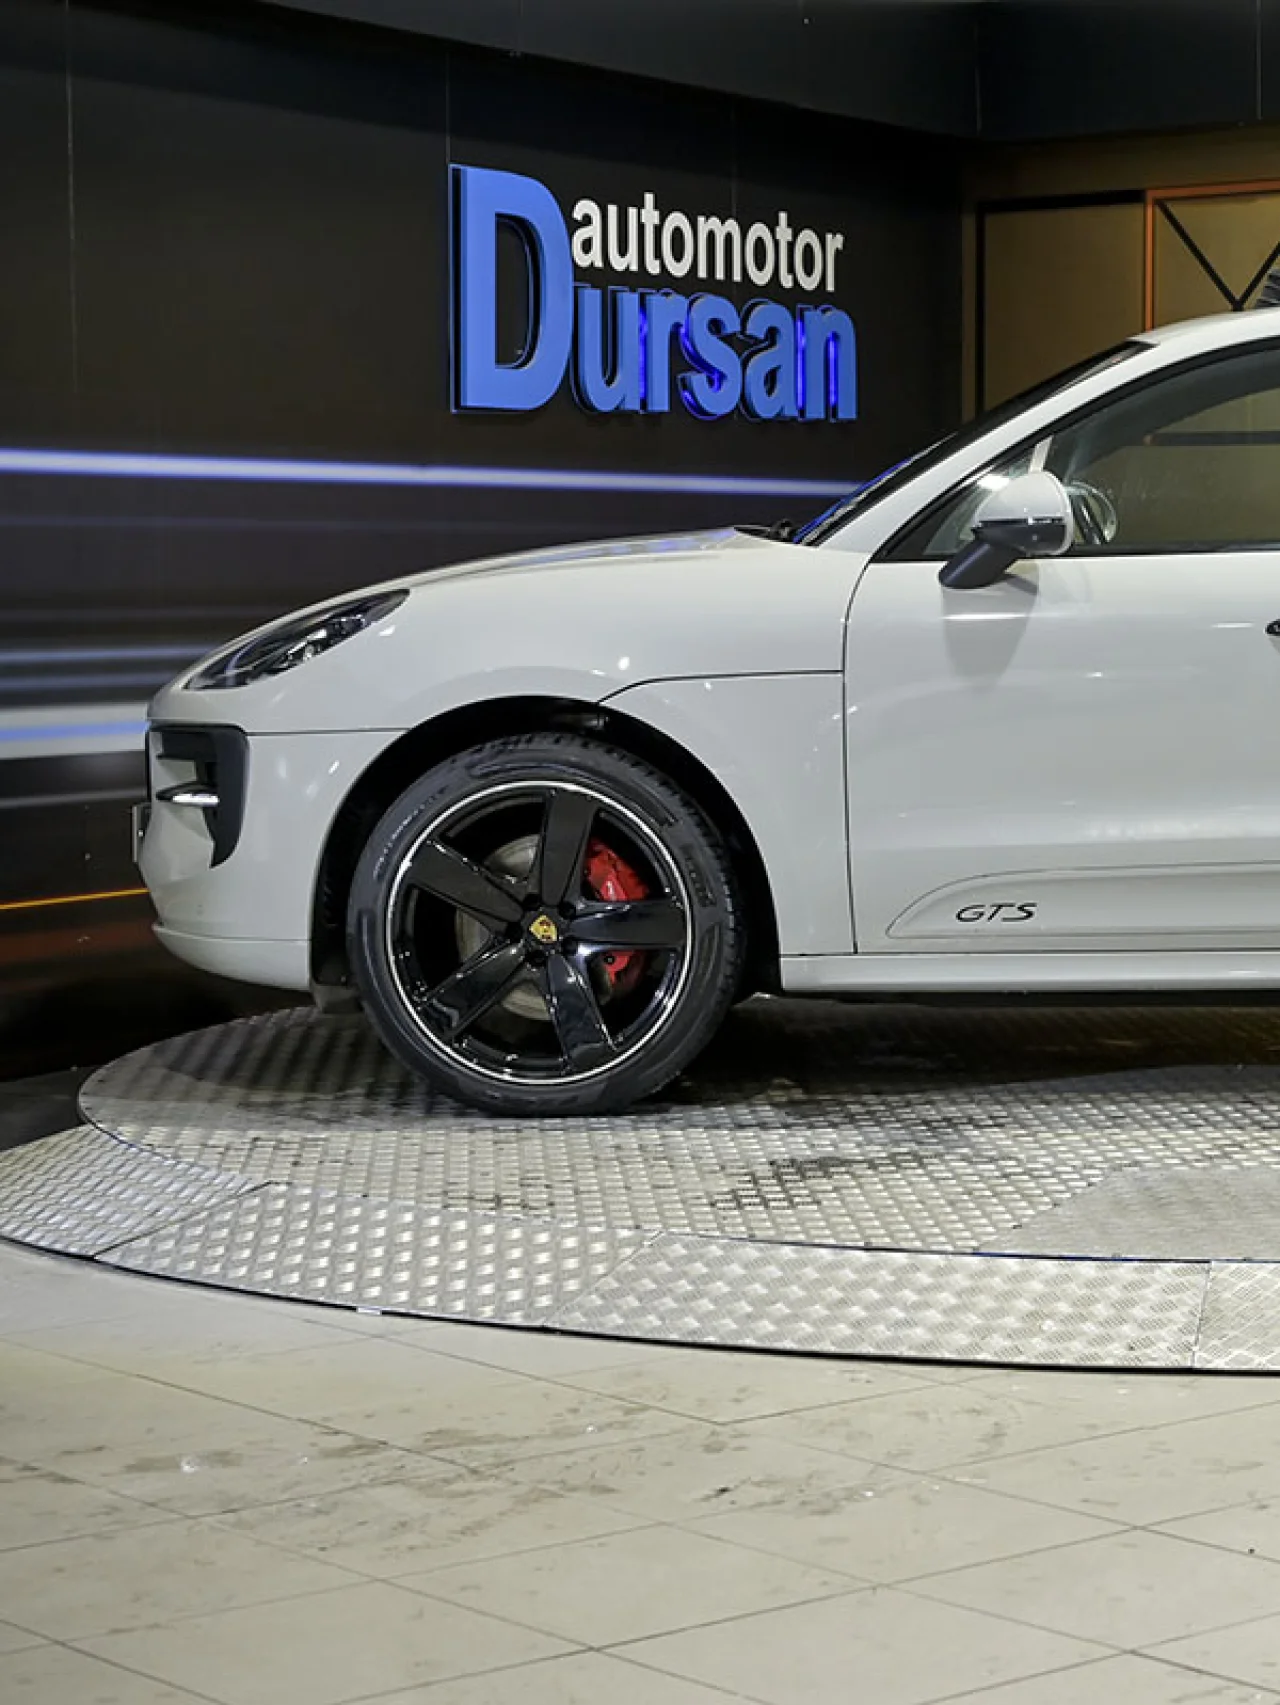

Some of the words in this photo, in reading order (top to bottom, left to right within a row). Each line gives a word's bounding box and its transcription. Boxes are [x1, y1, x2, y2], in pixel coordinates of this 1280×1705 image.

[571, 192, 844, 292] automotor
[448, 163, 858, 422] Dursan
[955, 902, 1038, 922] GTS
